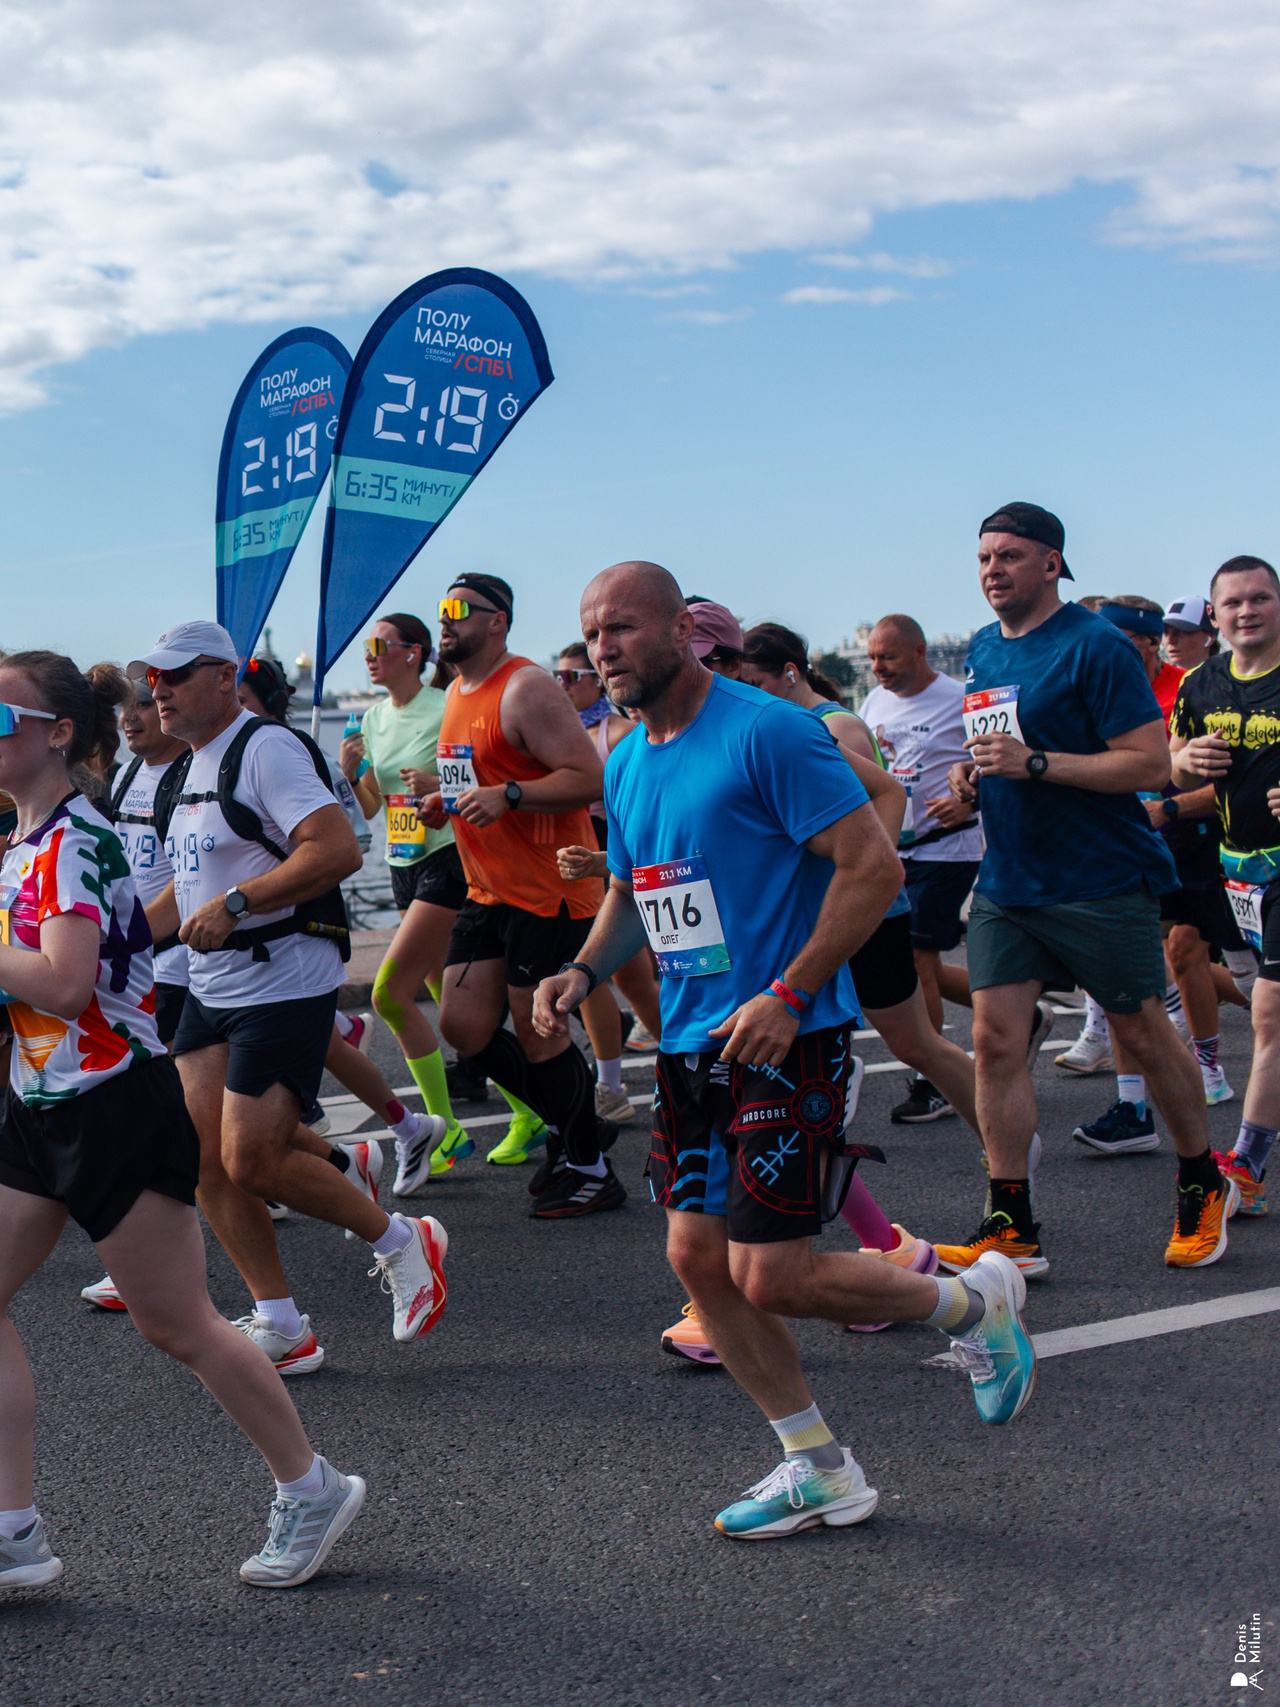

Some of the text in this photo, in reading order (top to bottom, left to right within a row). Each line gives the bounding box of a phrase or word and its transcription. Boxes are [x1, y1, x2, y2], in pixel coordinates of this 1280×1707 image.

[417, 307, 471, 331] ПОЛУ
[414, 326, 512, 358] МАРАФОН
[260, 375, 331, 408] МАРАФОН
[261, 368, 298, 392] ПОЛУ
[373, 373, 488, 454] 2:19
[242, 421, 317, 496] 2:19
[345, 470, 398, 502] 6:35
[233, 521, 266, 552] 6:35
[124, 799, 153, 809] МАРАФО
[128, 790, 147, 798] ПОЛУ
[660, 870, 675, 880] 21,1
[638, 893, 702, 932] 1716
[661, 934, 679, 945] ОЛЕГ
[742, 1107, 787, 1124] HARDCORE
